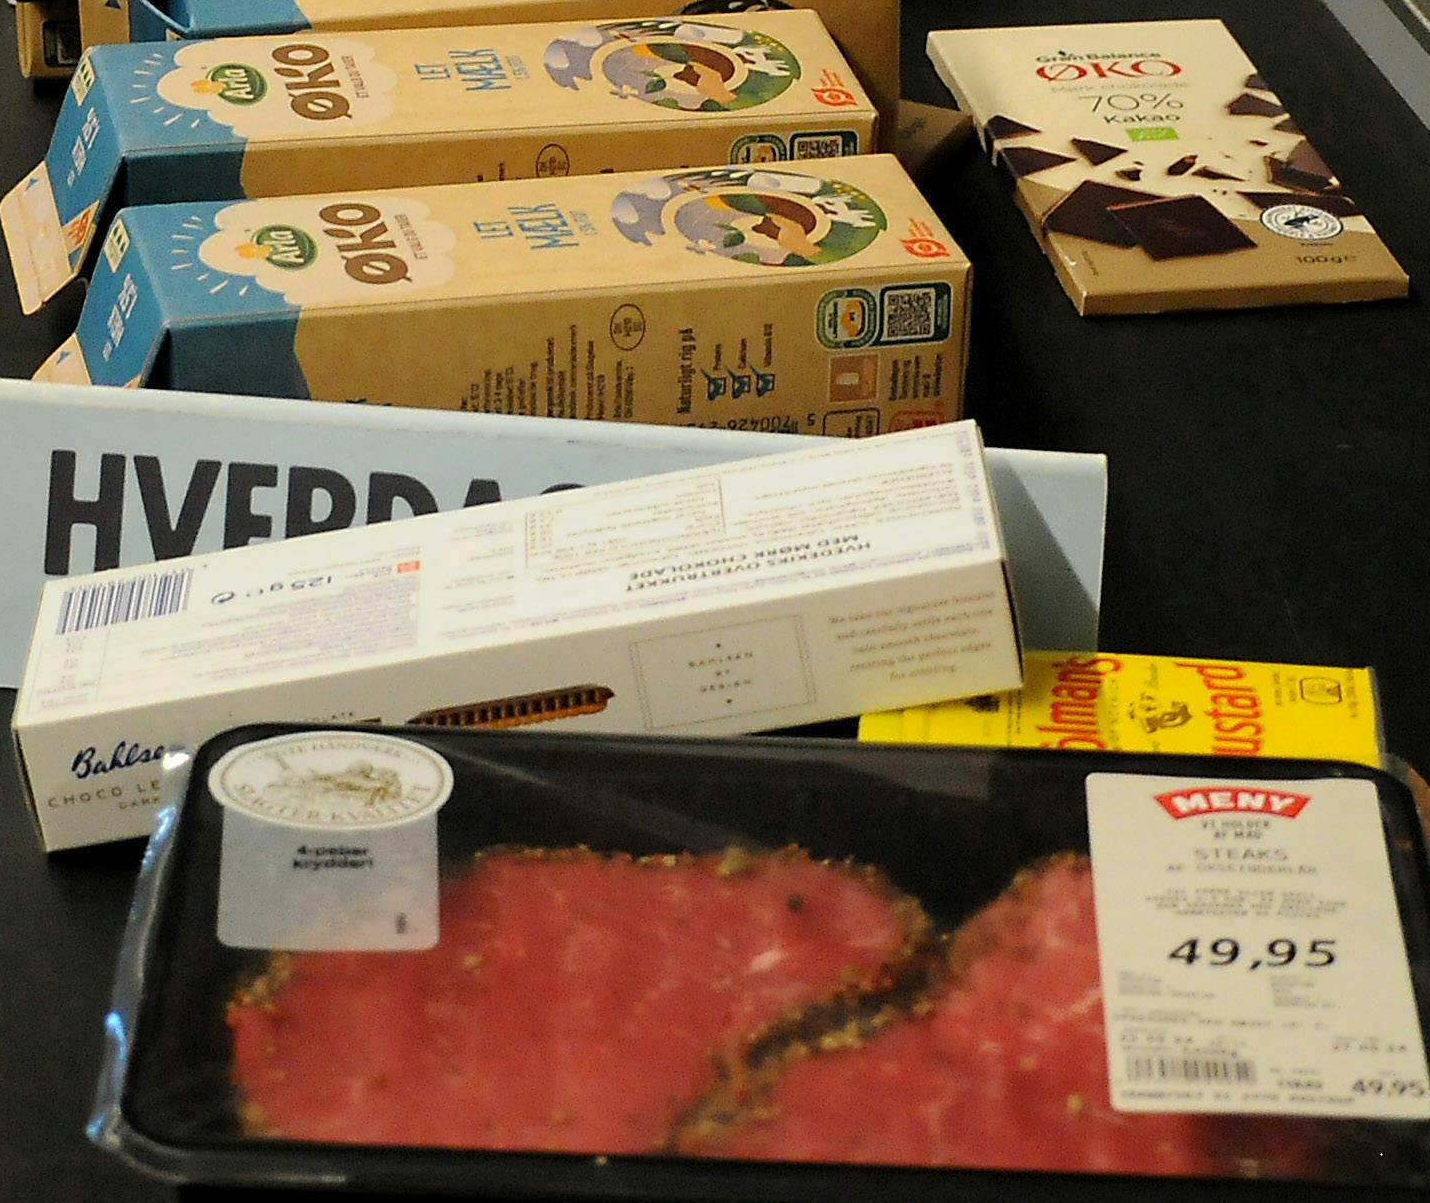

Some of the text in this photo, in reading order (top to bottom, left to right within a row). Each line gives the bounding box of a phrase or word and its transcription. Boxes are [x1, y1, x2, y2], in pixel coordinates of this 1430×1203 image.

[218, 43, 353, 120] Arla ØKO
[1036, 58, 1182, 83] ØKO
[1078, 92, 1185, 114] 70%
[1102, 112, 1182, 124] Kakao
[270, 202, 413, 285] Arla ØKO
[507, 202, 580, 251] MÆLK
[625, 541, 870, 592] HVEDEKIKS OVERTRUKKET
[627, 533, 859, 581] MED MØRK CHOKOLADE
[1033, 655, 1122, 750] olman's
[1175, 661, 1263, 757] ustard
[71, 740, 168, 781] Bahlse
[47, 784, 123, 810] CHOCO
[1170, 790, 1297, 815] MENY
[1194, 848, 1289, 862] STEAKS
[1167, 938, 1337, 971] 49,95
